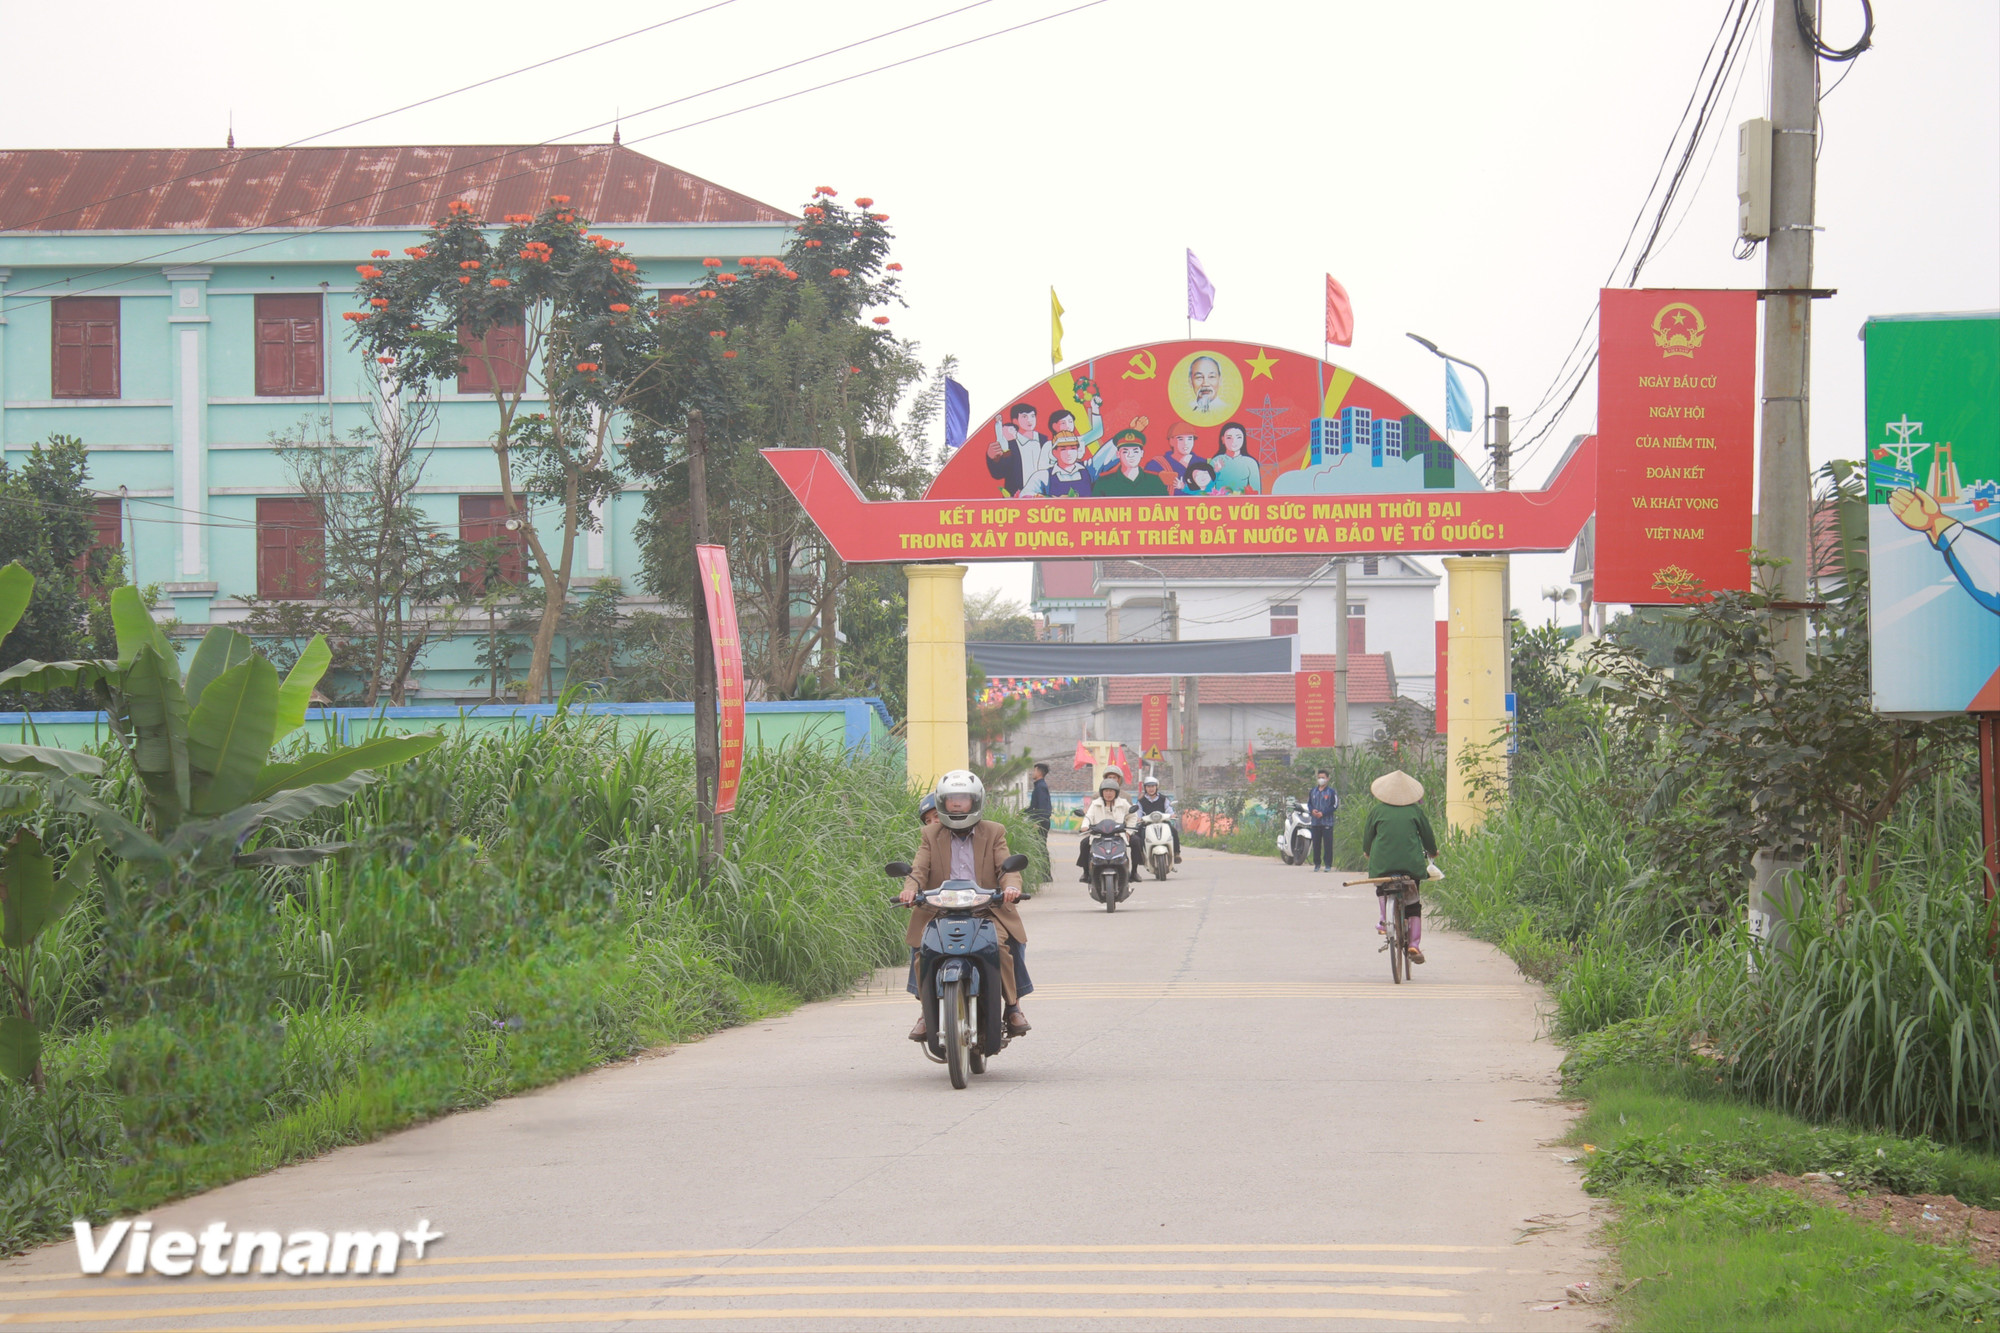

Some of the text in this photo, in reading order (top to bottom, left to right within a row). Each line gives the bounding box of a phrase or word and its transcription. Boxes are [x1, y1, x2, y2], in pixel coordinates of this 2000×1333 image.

[1638, 374, 1671, 388] NGÀY
[1700, 374, 1717, 389] CỬ
[1649, 405, 1705, 420] NGÀY HỘI
[1635, 434, 1660, 448] CỦA
[1694, 437, 1717, 450] TIN,
[1646, 464, 1705, 479] ĐOÀN KẾT
[1632, 495, 1719, 511] VÀ KHÁT VỌNG
[939, 499, 1461, 527] KẾT HỢP SỨC MẠNH DÂN TỘC VỚI SỨC MẠNH THỜI ĐẠI
[899, 533, 964, 549] TRONG
[970, 529, 1009, 548] XÂY
[1015, 530, 1075, 550] DỰNG,
[1081, 527, 1131, 546] PHÁT
[1137, 523, 1194, 545] TRIỂN
[1200, 523, 1238, 544] ĐẤT
[1243, 525, 1297, 544] NƯỚC
[1303, 524, 1329, 543] VÀ
[1335, 522, 1375, 542] BẢO
[1381, 523, 1405, 545] VỆ
[1411, 520, 1436, 541] TỔ
[1645, 526, 1705, 541] VIỆT NAM!
